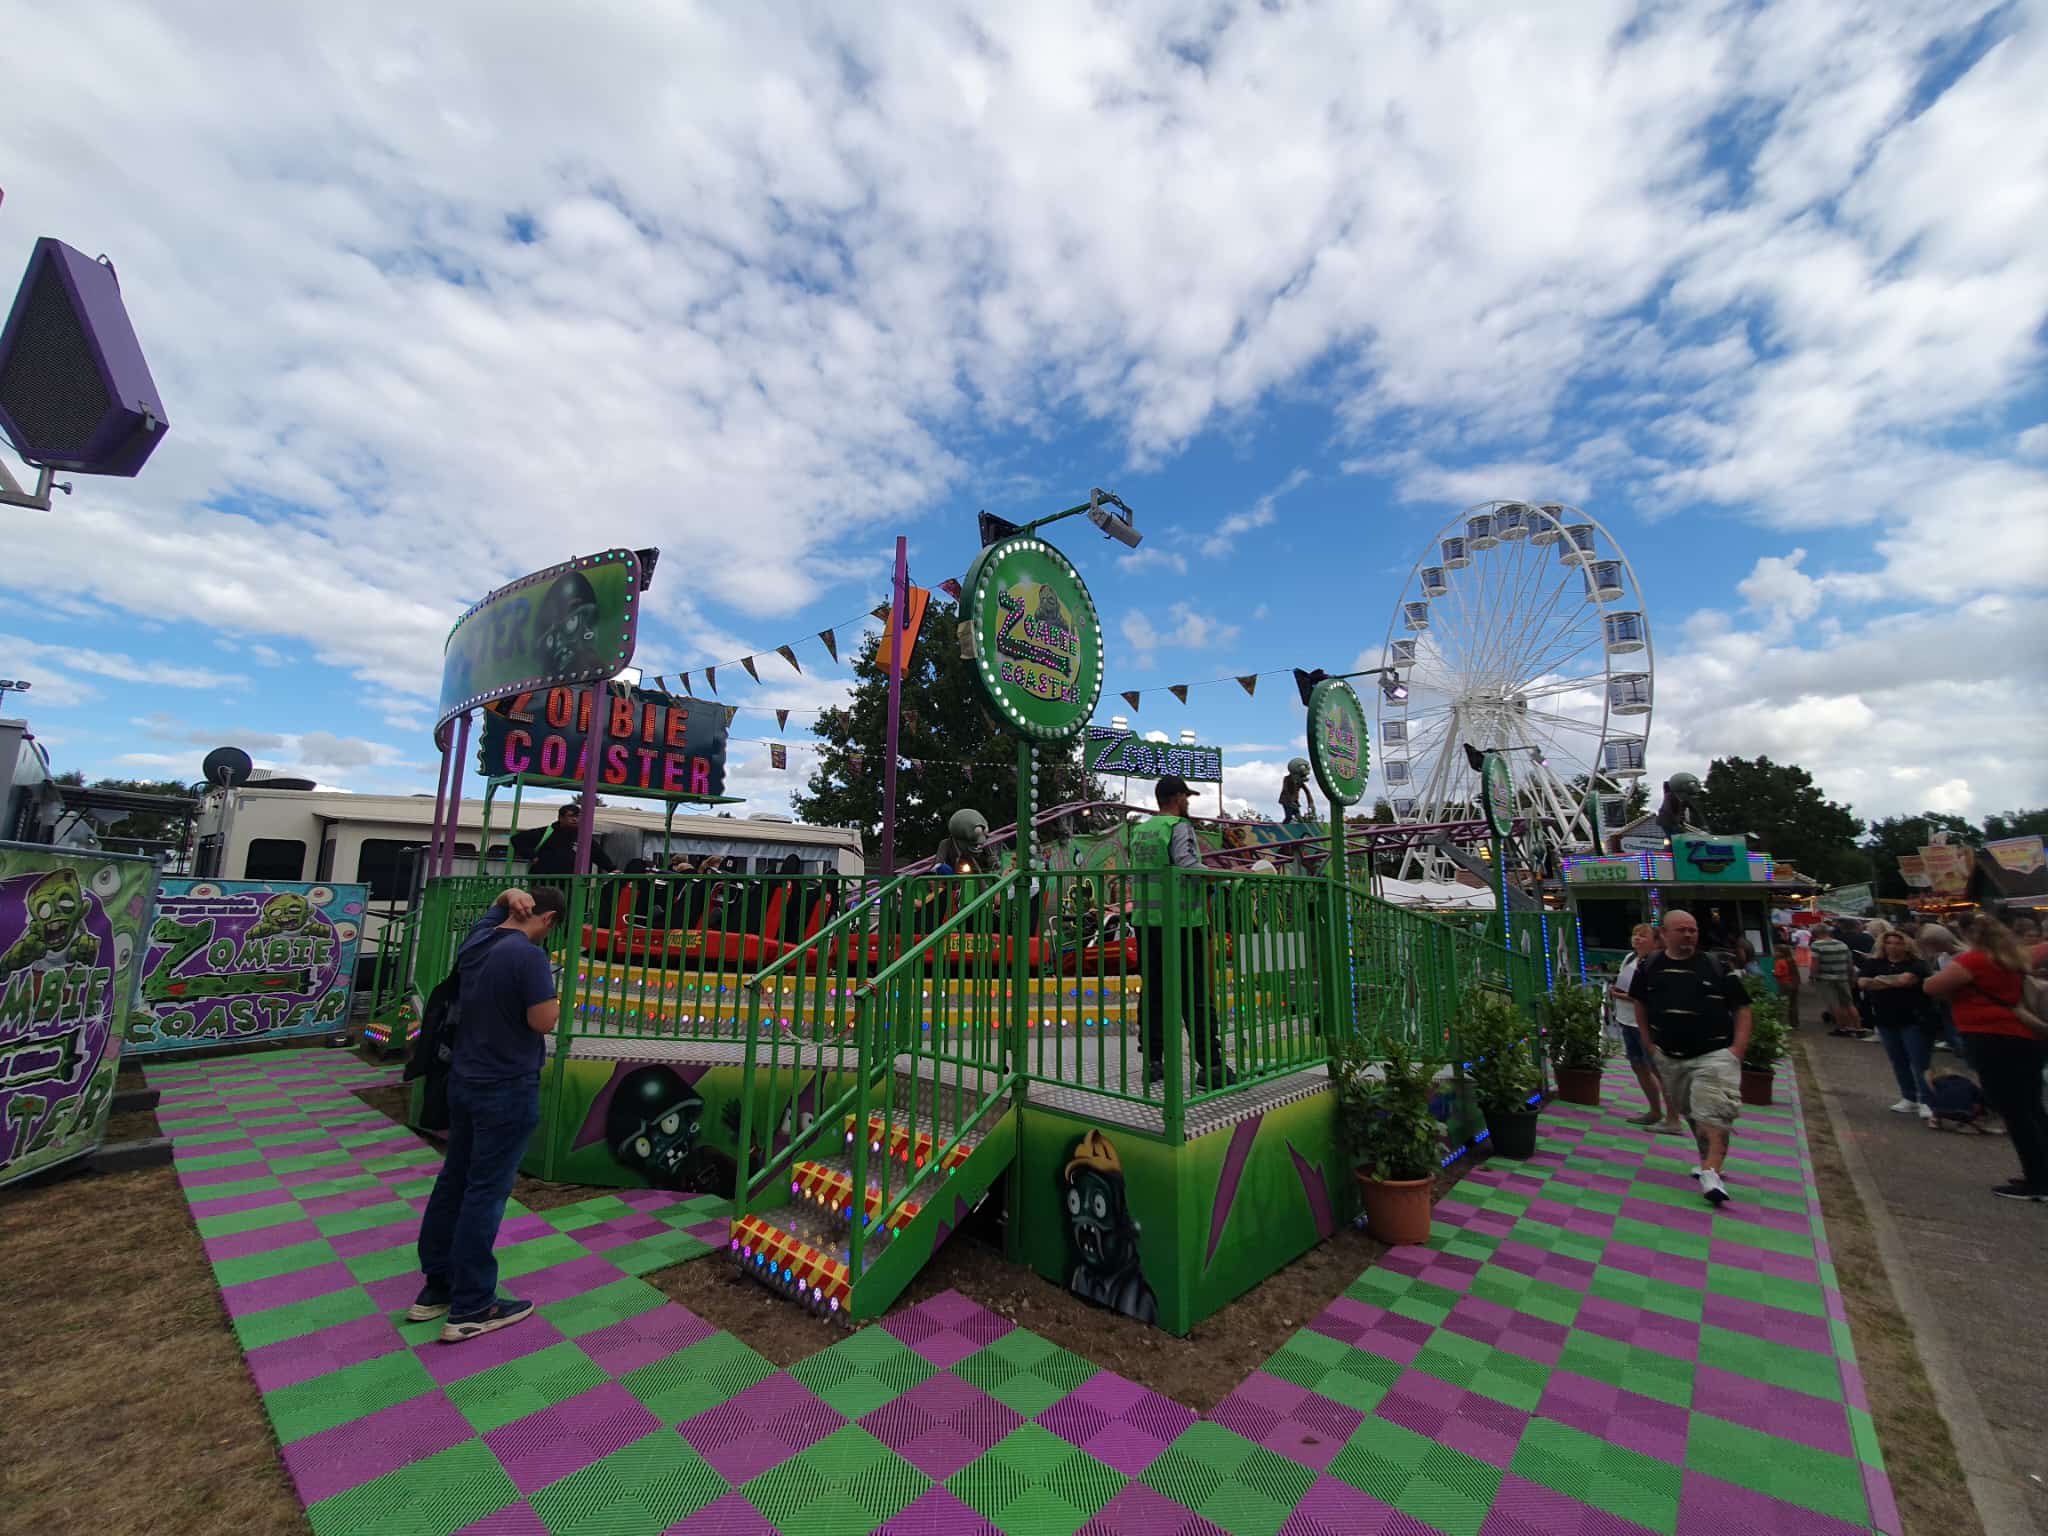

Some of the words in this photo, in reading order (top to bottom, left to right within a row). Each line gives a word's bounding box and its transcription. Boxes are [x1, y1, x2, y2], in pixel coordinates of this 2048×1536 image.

[1001, 662, 1081, 704] COASTER
[141, 917, 335, 1002] ZOMBIE
[127, 991, 346, 1045] COASTER
